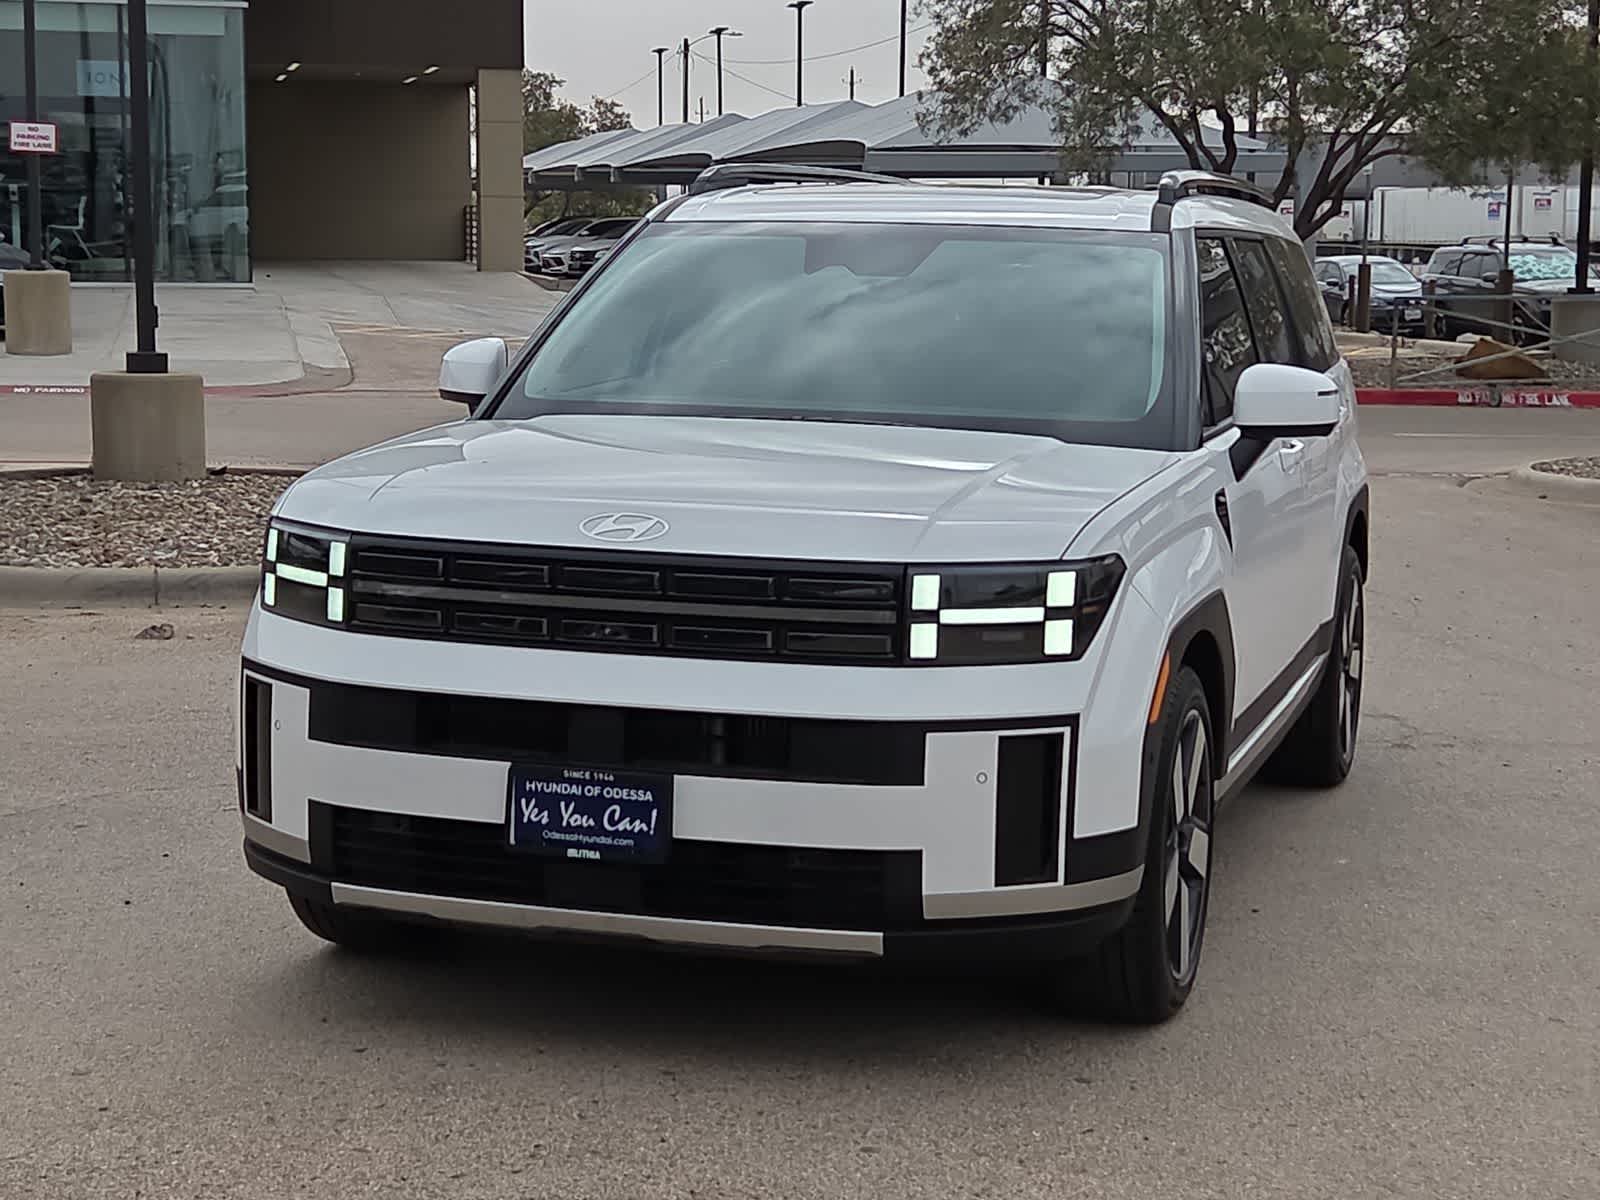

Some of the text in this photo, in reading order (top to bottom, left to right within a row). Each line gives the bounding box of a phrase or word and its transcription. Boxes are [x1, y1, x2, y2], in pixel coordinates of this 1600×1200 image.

[16, 133, 50, 141] PARKING
[563, 769, 591, 779] SINCE
[526, 780, 653, 802] HYUNDAI OF ODESSA
[520, 798, 658, 836] Yes You Can!
